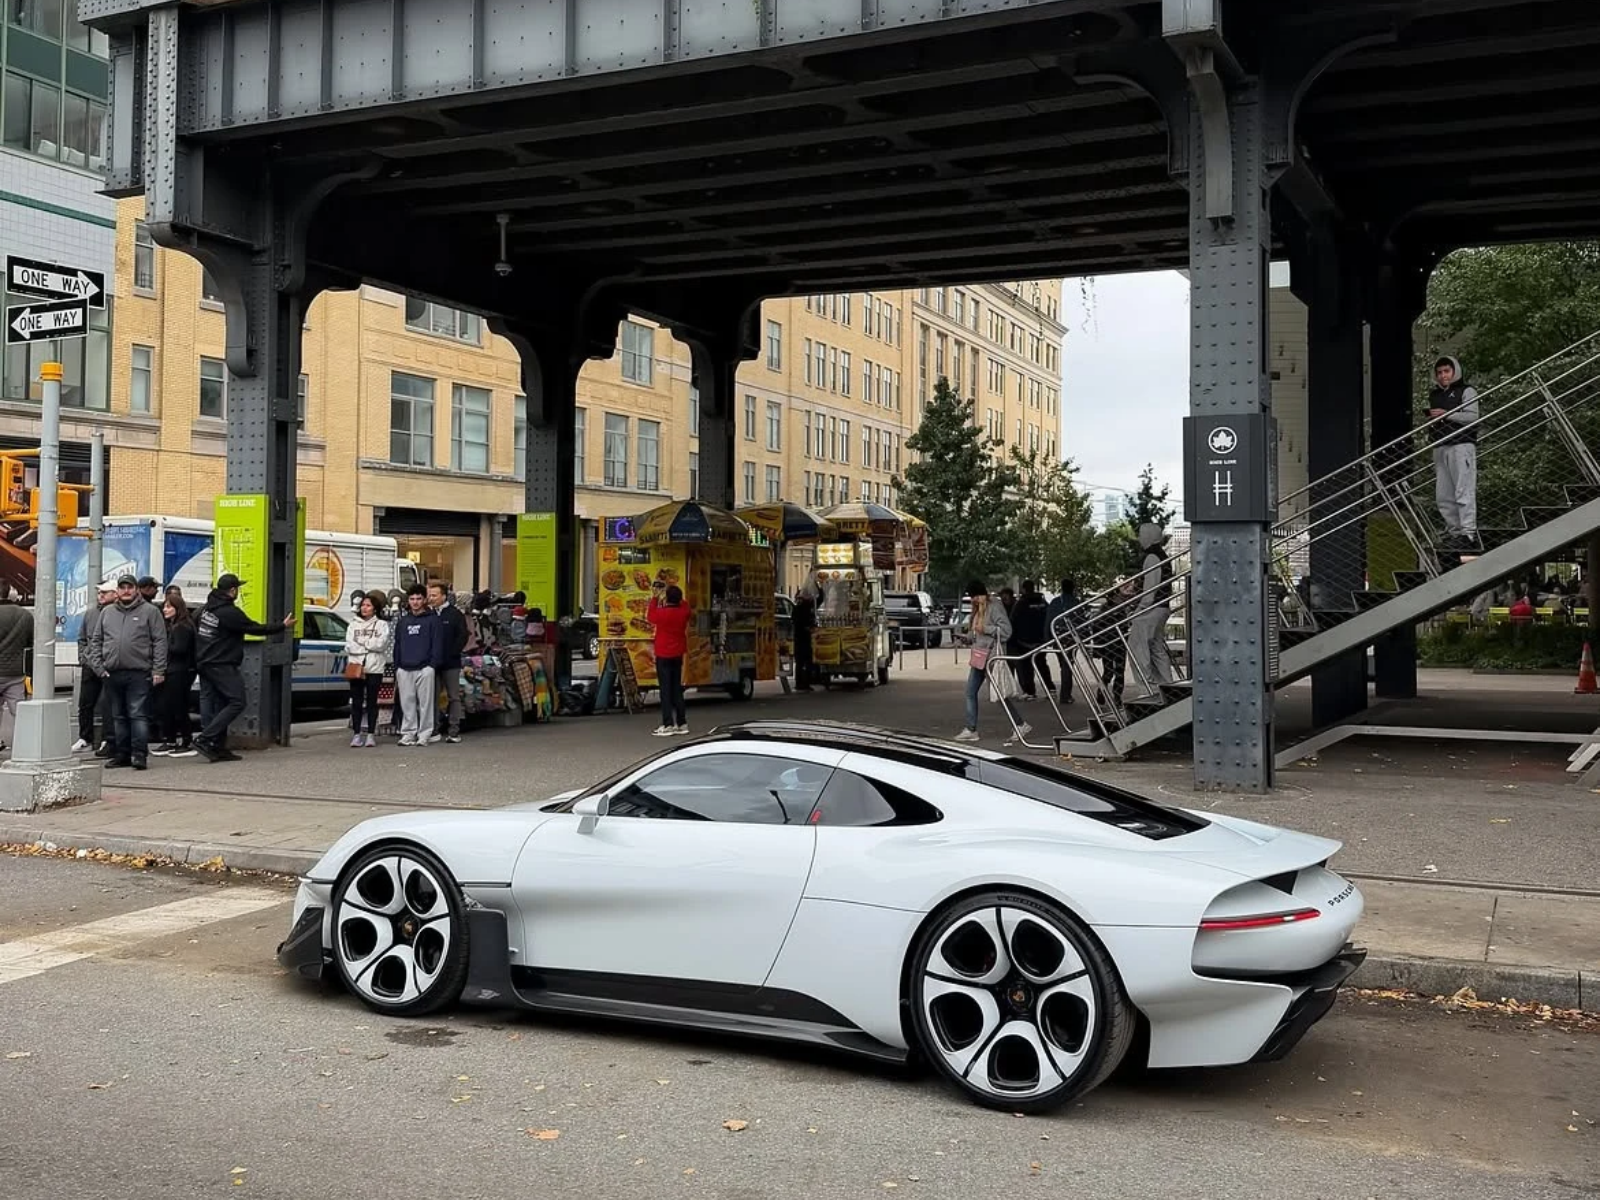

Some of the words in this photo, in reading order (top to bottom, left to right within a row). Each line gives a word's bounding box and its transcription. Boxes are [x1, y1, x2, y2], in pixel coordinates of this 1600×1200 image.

[21, 269, 49, 288] ONE
[62, 277, 90, 295] WAY
[20, 315, 42, 331] ONE
[53, 310, 77, 327] WAY
[1327, 883, 1355, 906] PORSCH
